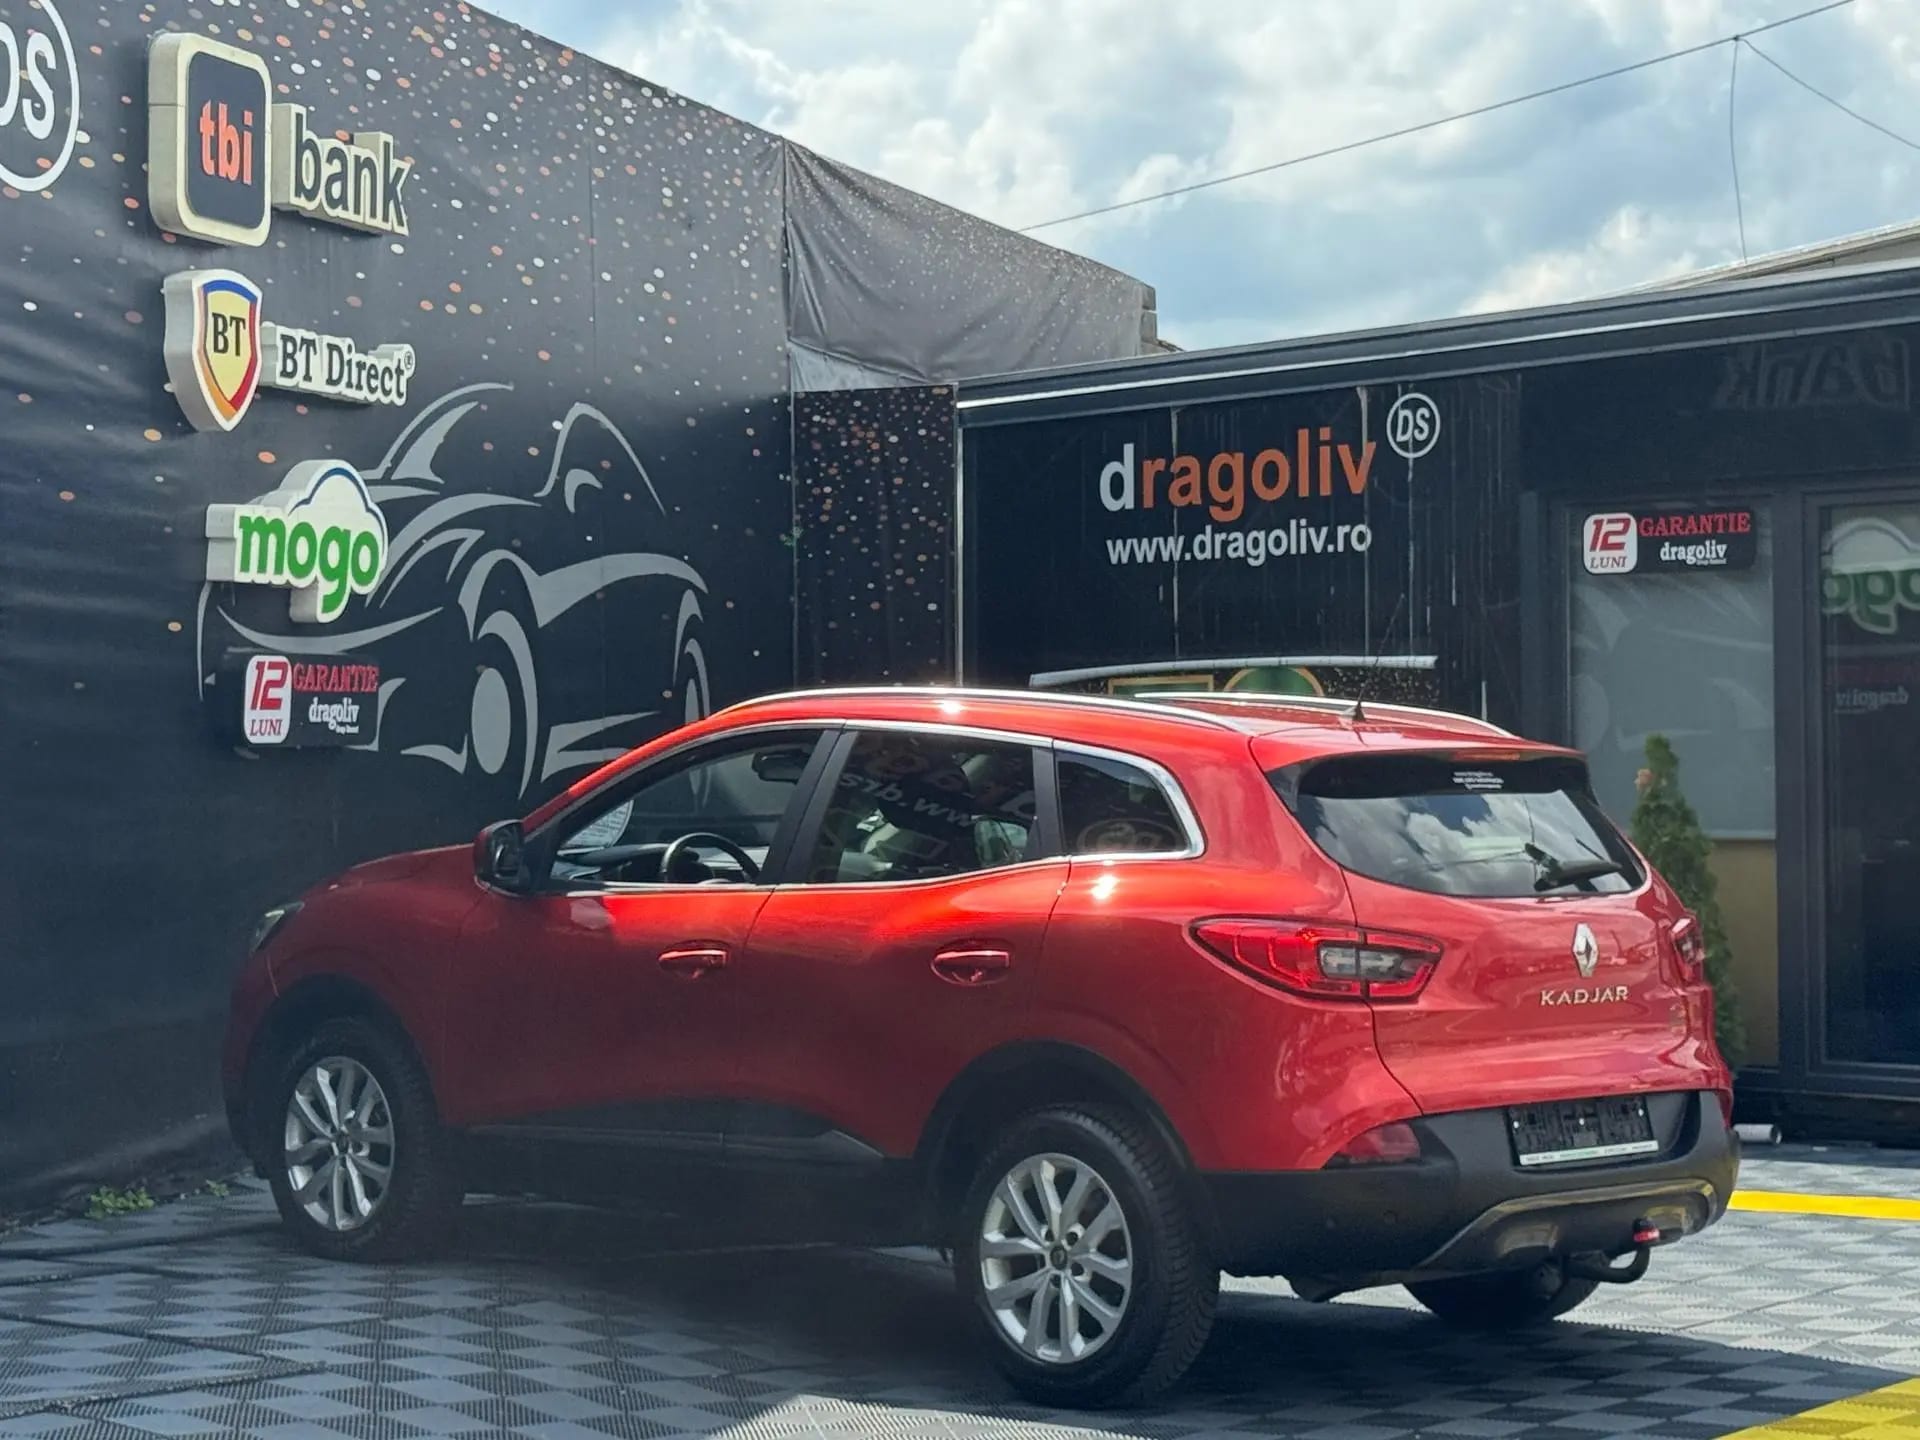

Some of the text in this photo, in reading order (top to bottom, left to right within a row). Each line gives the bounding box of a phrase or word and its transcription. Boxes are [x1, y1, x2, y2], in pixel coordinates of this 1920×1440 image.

[200, 100, 253, 186] tbi
[295, 111, 406, 228] bank
[212, 312, 246, 357] BT
[280, 333, 317, 383] BT
[1396, 407, 1430, 443] DS
[1100, 427, 1377, 522] dragoliv
[1106, 518, 1373, 567] www.dragoliv.ro
[1589, 518, 1631, 553] 12
[1638, 512, 1751, 537] GARANTIE
[239, 516, 380, 614] mogo
[1590, 556, 1627, 569] LUNI
[1660, 539, 1727, 565] dragoliv
[250, 661, 289, 711] 12
[293, 662, 379, 693] GARANTIE
[249, 718, 284, 737] LUNI
[308, 696, 360, 731] dragoliv
[1539, 986, 1630, 1007] KADJAR
